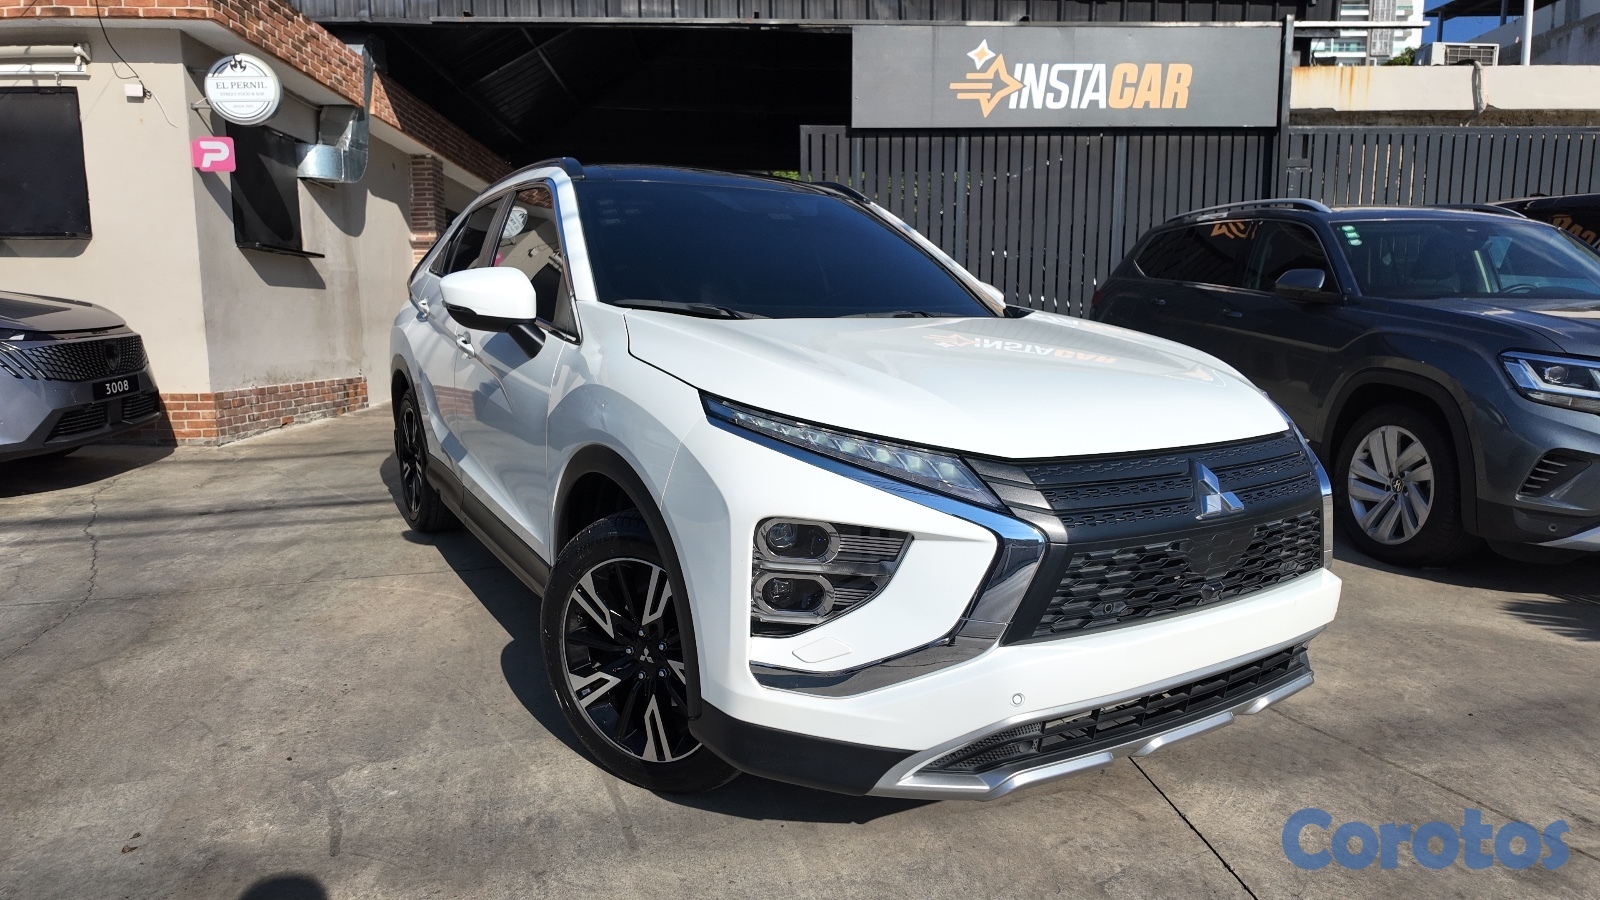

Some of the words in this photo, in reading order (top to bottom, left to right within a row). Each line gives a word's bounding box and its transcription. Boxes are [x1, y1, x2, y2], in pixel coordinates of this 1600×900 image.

[216, 81, 229, 90] EL
[230, 81, 268, 90] PERNIL
[1008, 63, 1193, 109] INSTACAR
[199, 141, 230, 168] P
[105, 379, 129, 395] 3008
